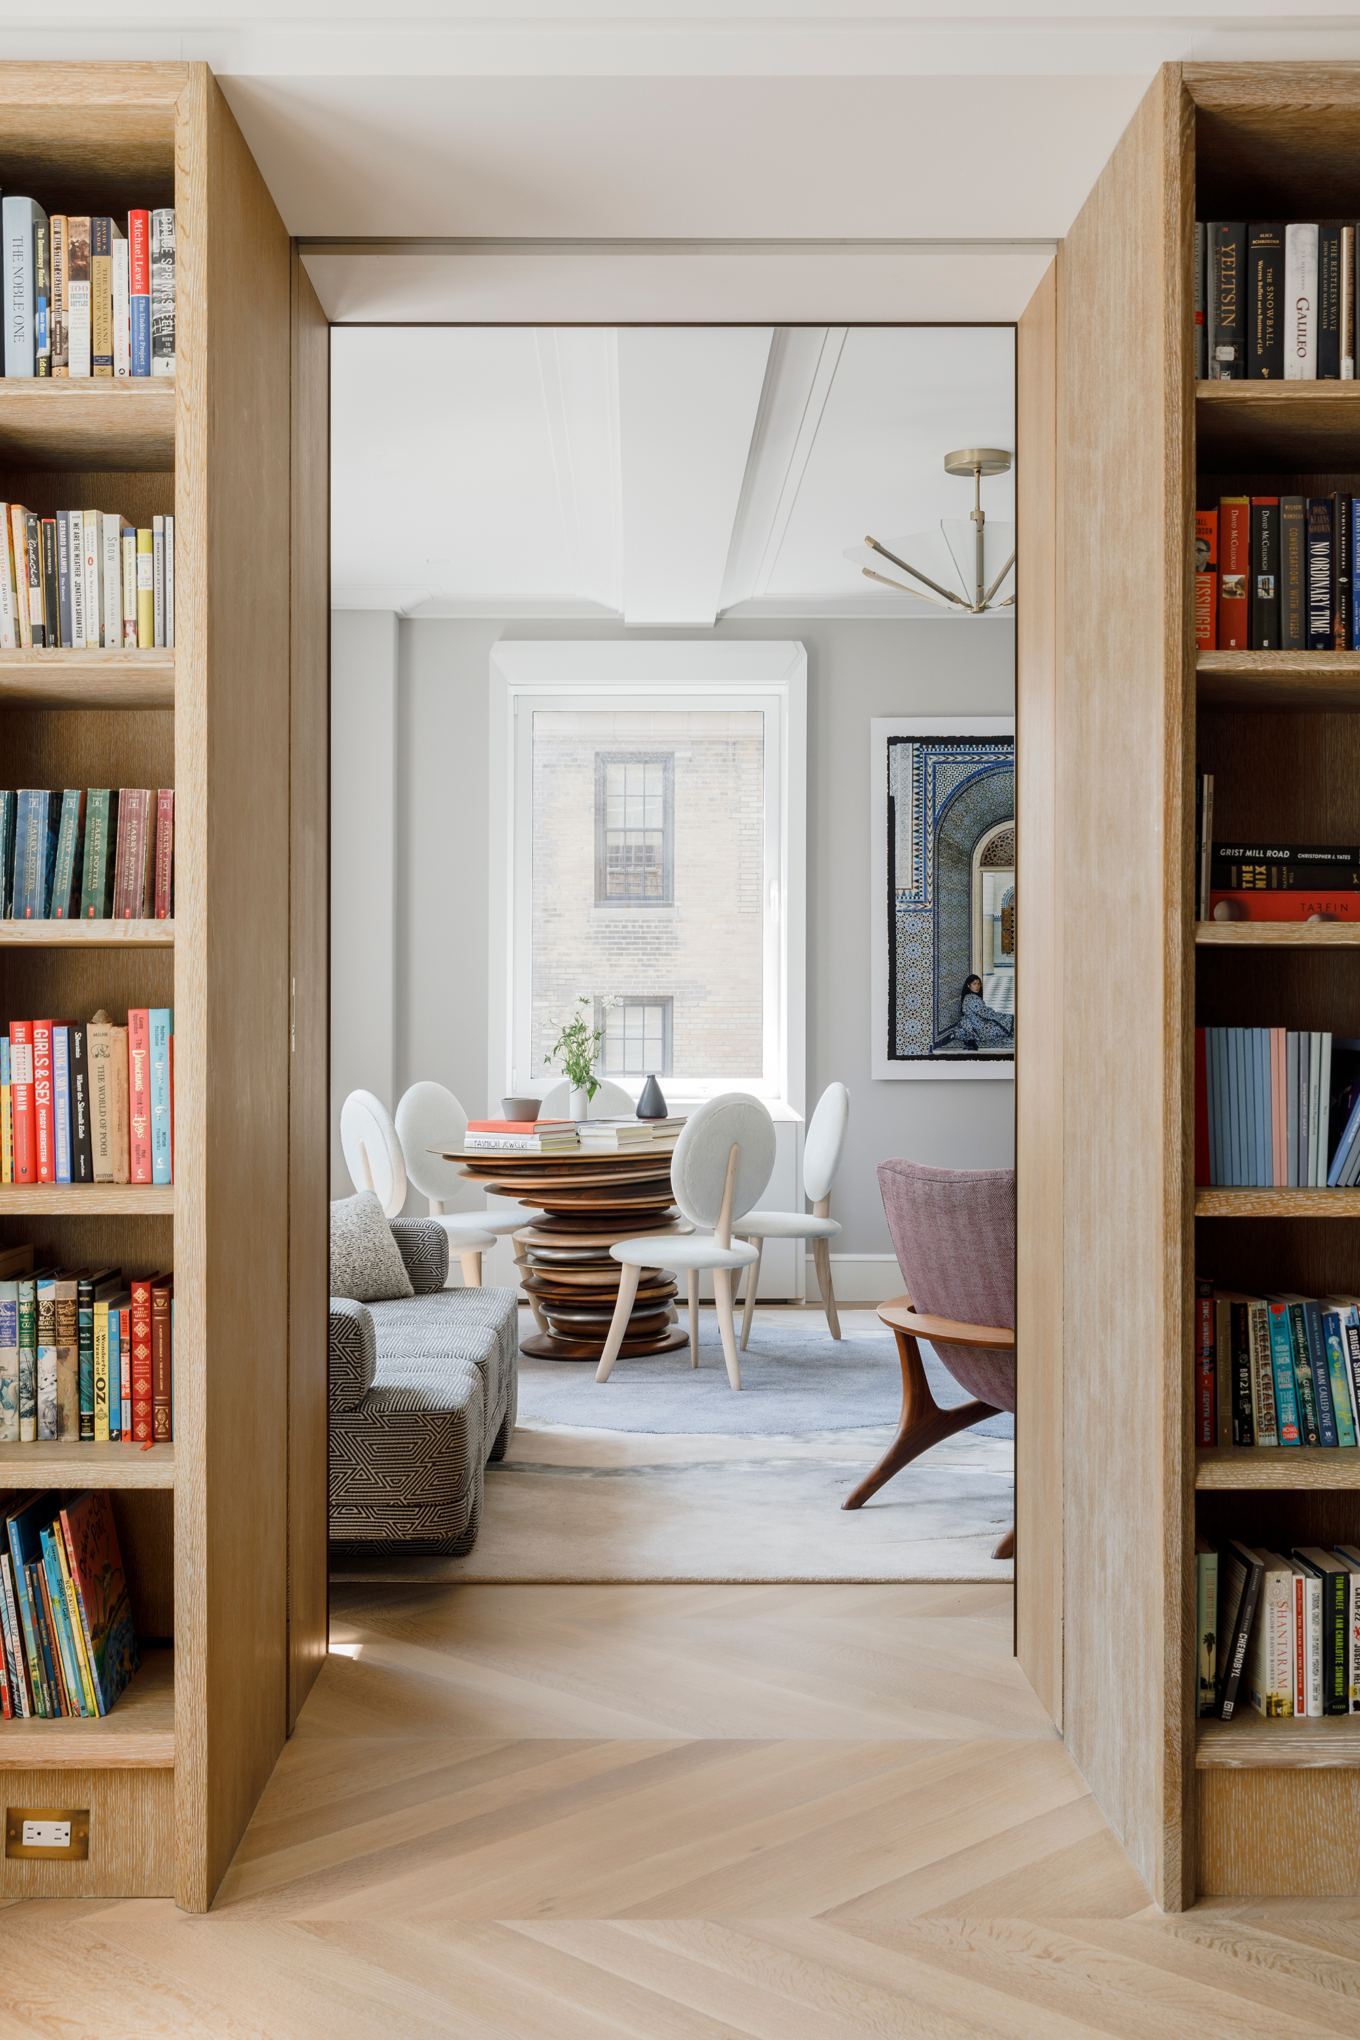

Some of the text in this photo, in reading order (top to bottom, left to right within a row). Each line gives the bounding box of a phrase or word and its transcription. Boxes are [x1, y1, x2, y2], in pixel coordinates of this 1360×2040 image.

[53, 220, 62, 232] HOW
[53, 233, 62, 249] WALL
[53, 250, 62, 269] STREET
[134, 219, 143, 290] Michael Lewis
[12, 236, 25, 343] THE NOBLE ONE
[53, 270, 62, 295] CREATED
[161, 216, 173, 334] BRUCE SPRINGSTEEN
[1221, 243, 1236, 327] YELTSIN
[53, 301, 62, 322] NATION
[96, 301, 102, 313] OF
[1266, 286, 1274, 347] SNOWBALL
[1296, 297, 1310, 358] GALILEO
[73, 522, 80, 531] WE
[107, 536, 118, 562] Snow
[74, 581, 82, 607] JONATHAN
[1289, 527, 1299, 639] CONVERSATIONS WITH MYSELF
[1310, 541, 1330, 635] NO ORDINARY TIME
[1196, 576, 1211, 639] KISSINGER
[130, 820, 138, 854] HARRY
[61, 820, 74, 890] HARRY POTTER
[1220, 848, 1290, 858] GRIST MILL ROAD
[91, 855, 99, 889] POTTER
[1242, 865, 1254, 889] THE
[1255, 865, 1267, 889] NIX
[15, 1027, 25, 1042] THE
[16, 1046, 27, 1082] TEENAGE
[34, 1029, 50, 1105] GIRLS & SEX
[55, 1036, 66, 1067] RAISING
[17, 1085, 27, 1111] BRAIN
[56, 1076, 66, 1091] SON
[97, 1065, 108, 1156] THE WORLD OF POOH
[1201, 1300, 1210, 1375] SING, UNBURIED, SING
[1348, 1329, 1359, 1360] BRIGHT
[95, 1367, 100, 1376] of
[1256, 1308, 1275, 1433] MICHAEL CHABON
[1276, 1356, 1290, 1365] UNION
[1315, 1367, 1326, 1385] MAN
[96, 1377, 106, 1405] OZ
[1279, 1391, 1293, 1403] THE
[1301, 1379, 1315, 1430] GEORGE SAUNDERS
[1318, 1385, 1330, 1411] CALLED
[1202, 1389, 1210, 1442] JESMYN WARD
[1321, 1411, 1332, 1427] OVE
[1335, 1576, 1344, 1610] TOM WOLFE
[1335, 1619, 1344, 1629] AM
[1230, 1632, 1248, 1678] CHERNOBYL
[1276, 1601, 1289, 1689] SHANTARAM
[1335, 1630, 1344, 1664] CHARLOTTE
[1334, 1666, 1343, 1697] SIMMONS
